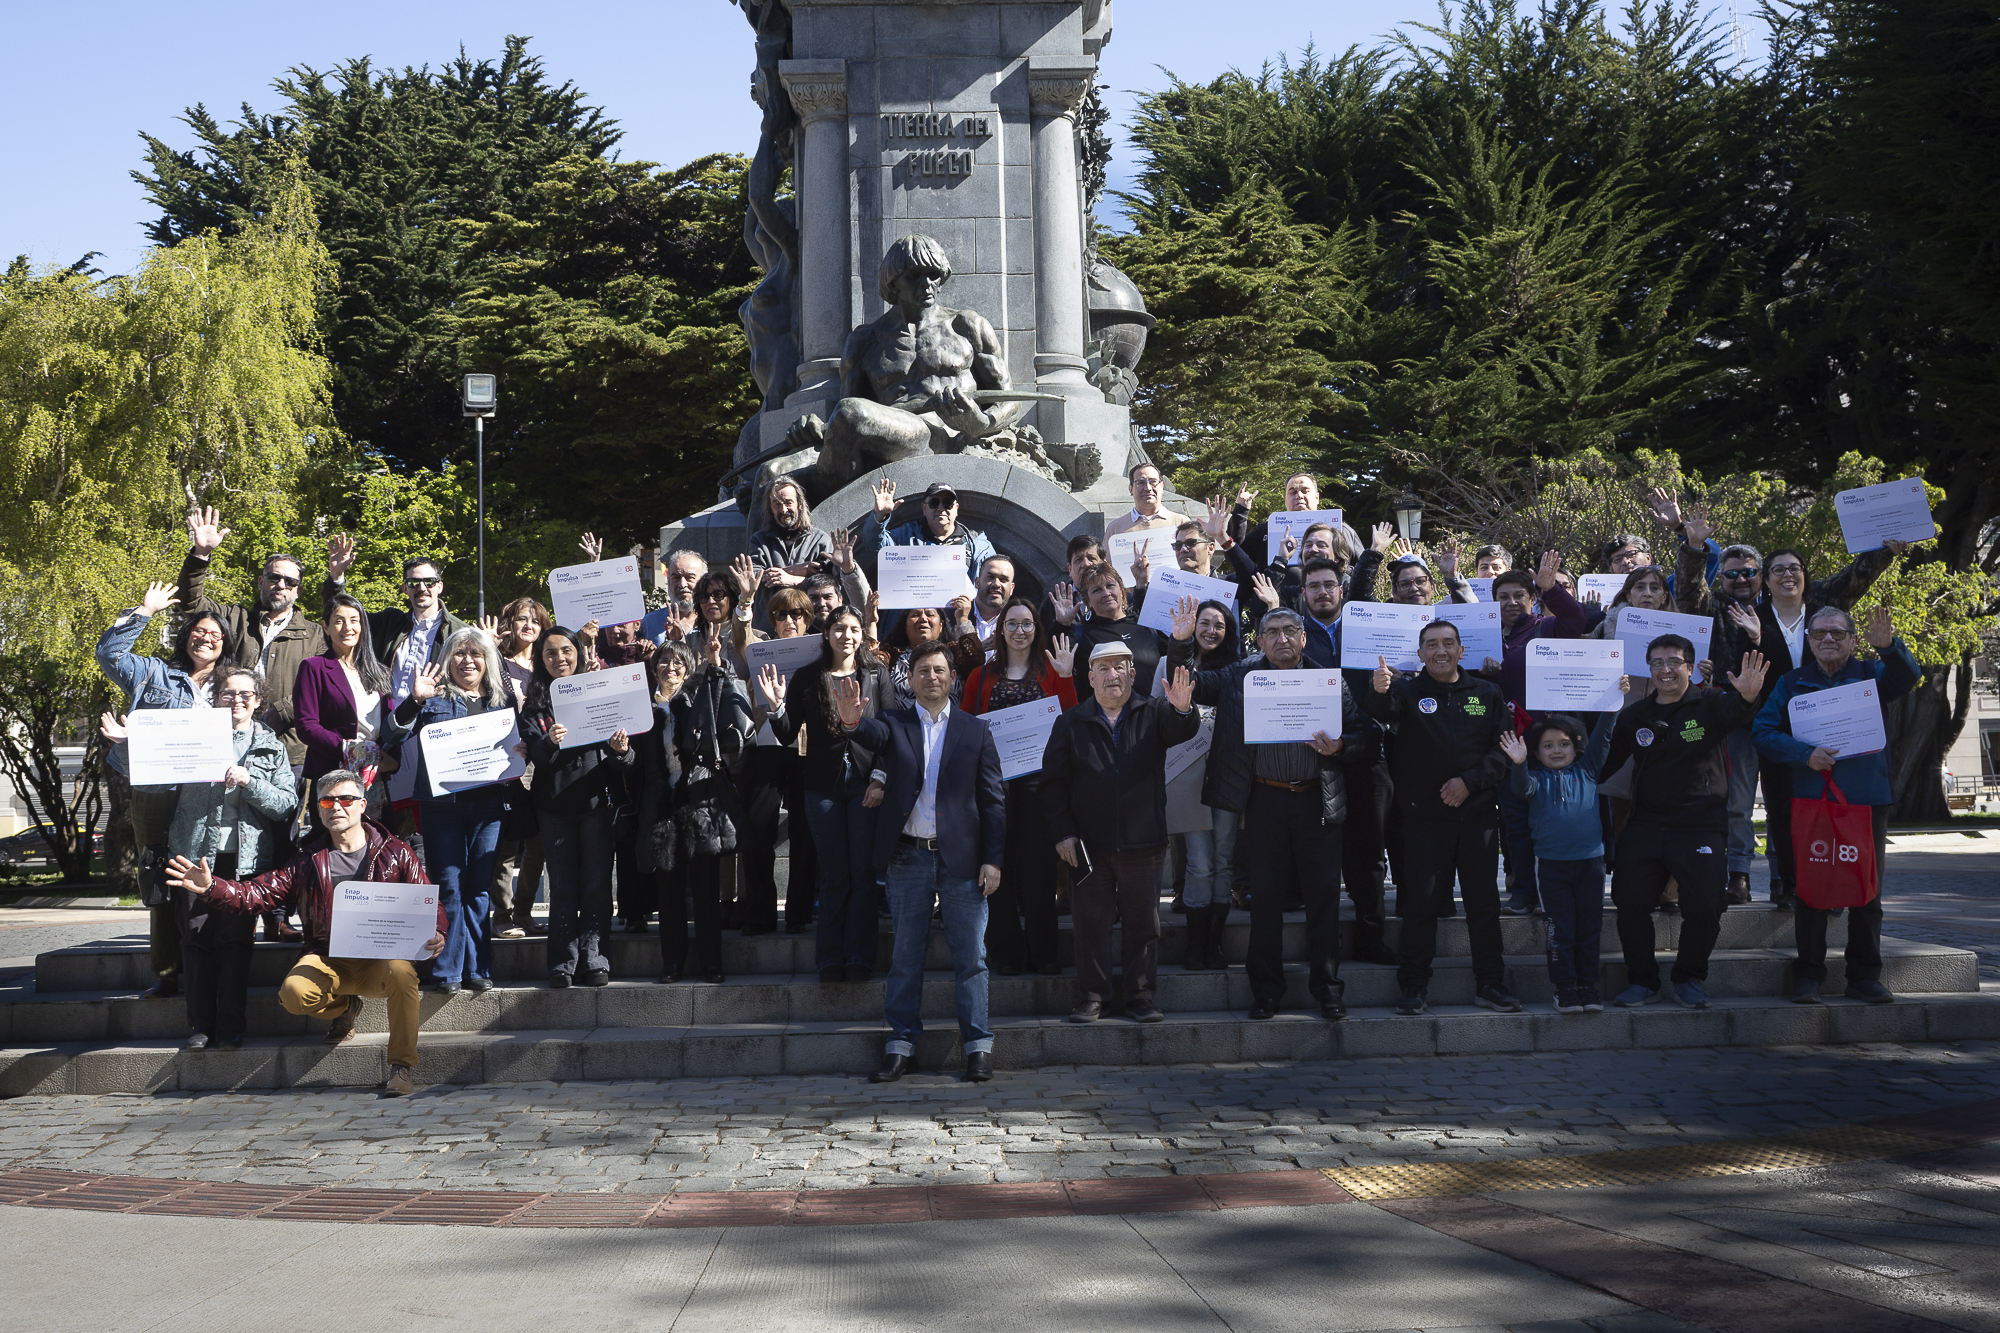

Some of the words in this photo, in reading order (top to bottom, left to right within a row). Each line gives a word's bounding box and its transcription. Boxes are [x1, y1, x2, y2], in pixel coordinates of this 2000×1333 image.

[885, 113, 955, 137] TIERRA
[964, 118, 994, 136] DEL
[909, 152, 972, 176] FUEGO
[559, 686, 582, 694] Impulsa
[1685, 720, 1697, 729] Z8
[429, 732, 452, 740] Impulsa
